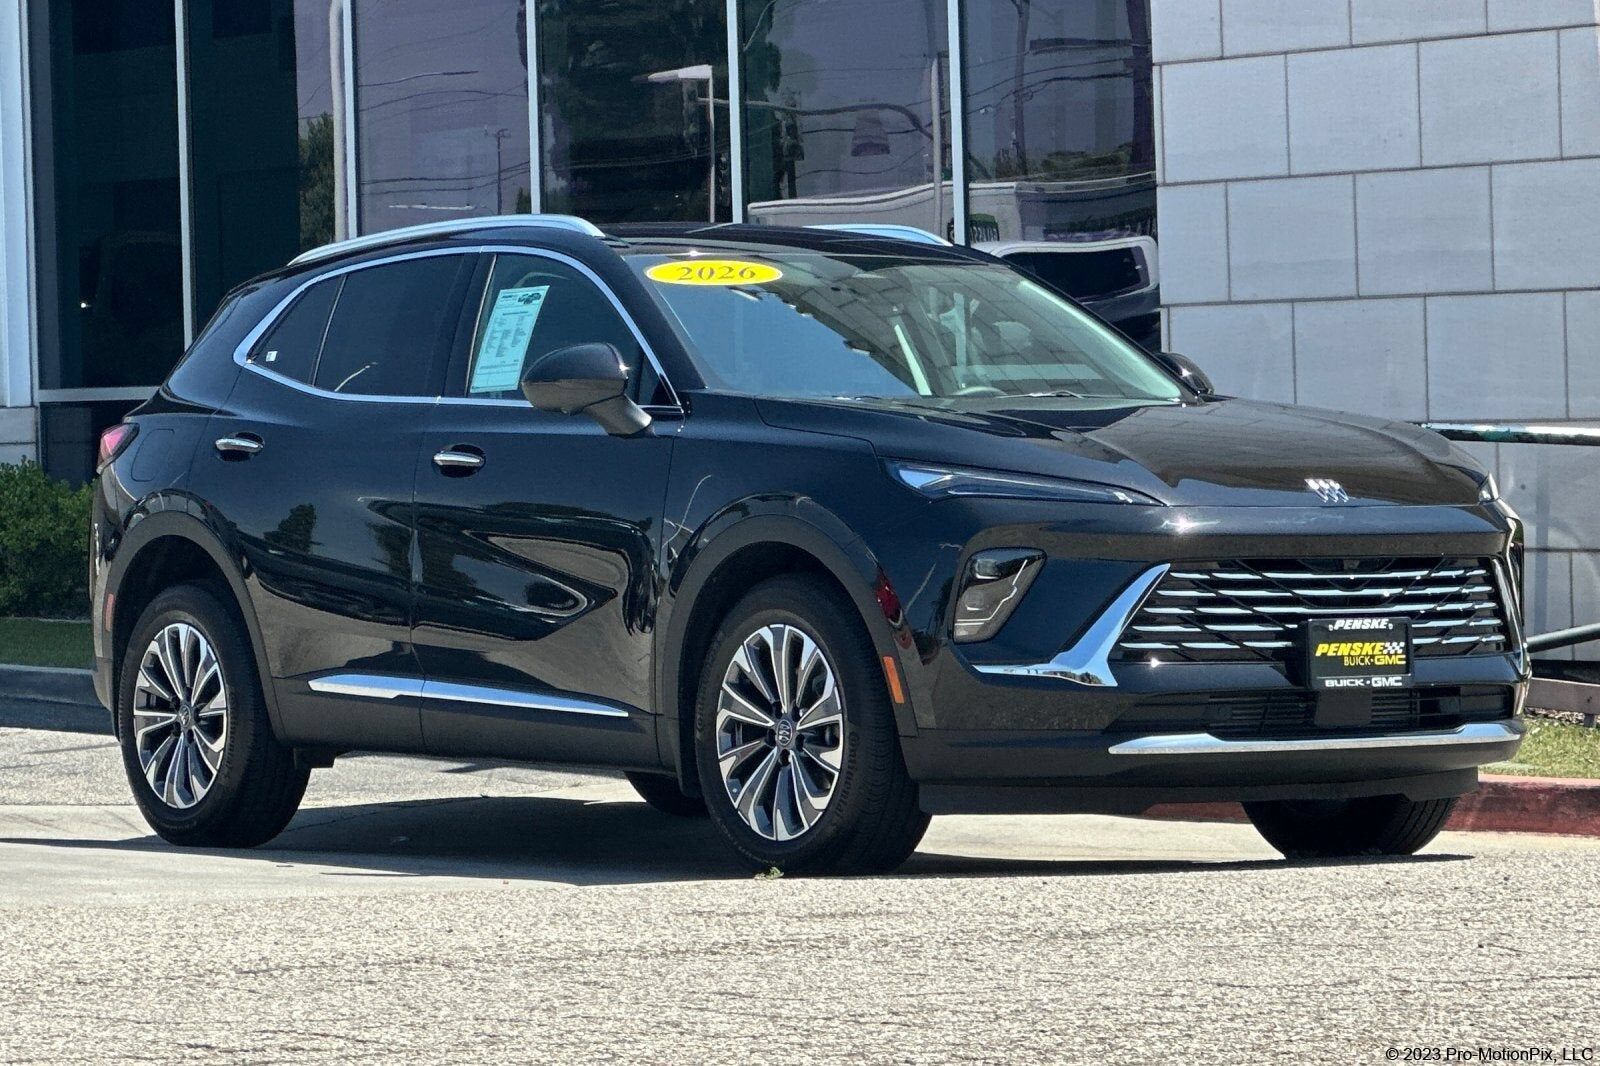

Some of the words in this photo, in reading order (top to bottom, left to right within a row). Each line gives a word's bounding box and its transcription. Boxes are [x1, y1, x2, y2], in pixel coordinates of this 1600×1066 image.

[677, 266, 756, 280] 2026
[1333, 619, 1389, 630] PENSKE
[1315, 642, 1385, 656] PENSKE
[1325, 679, 1365, 687] BUICK
[1371, 676, 1402, 687] GMC
